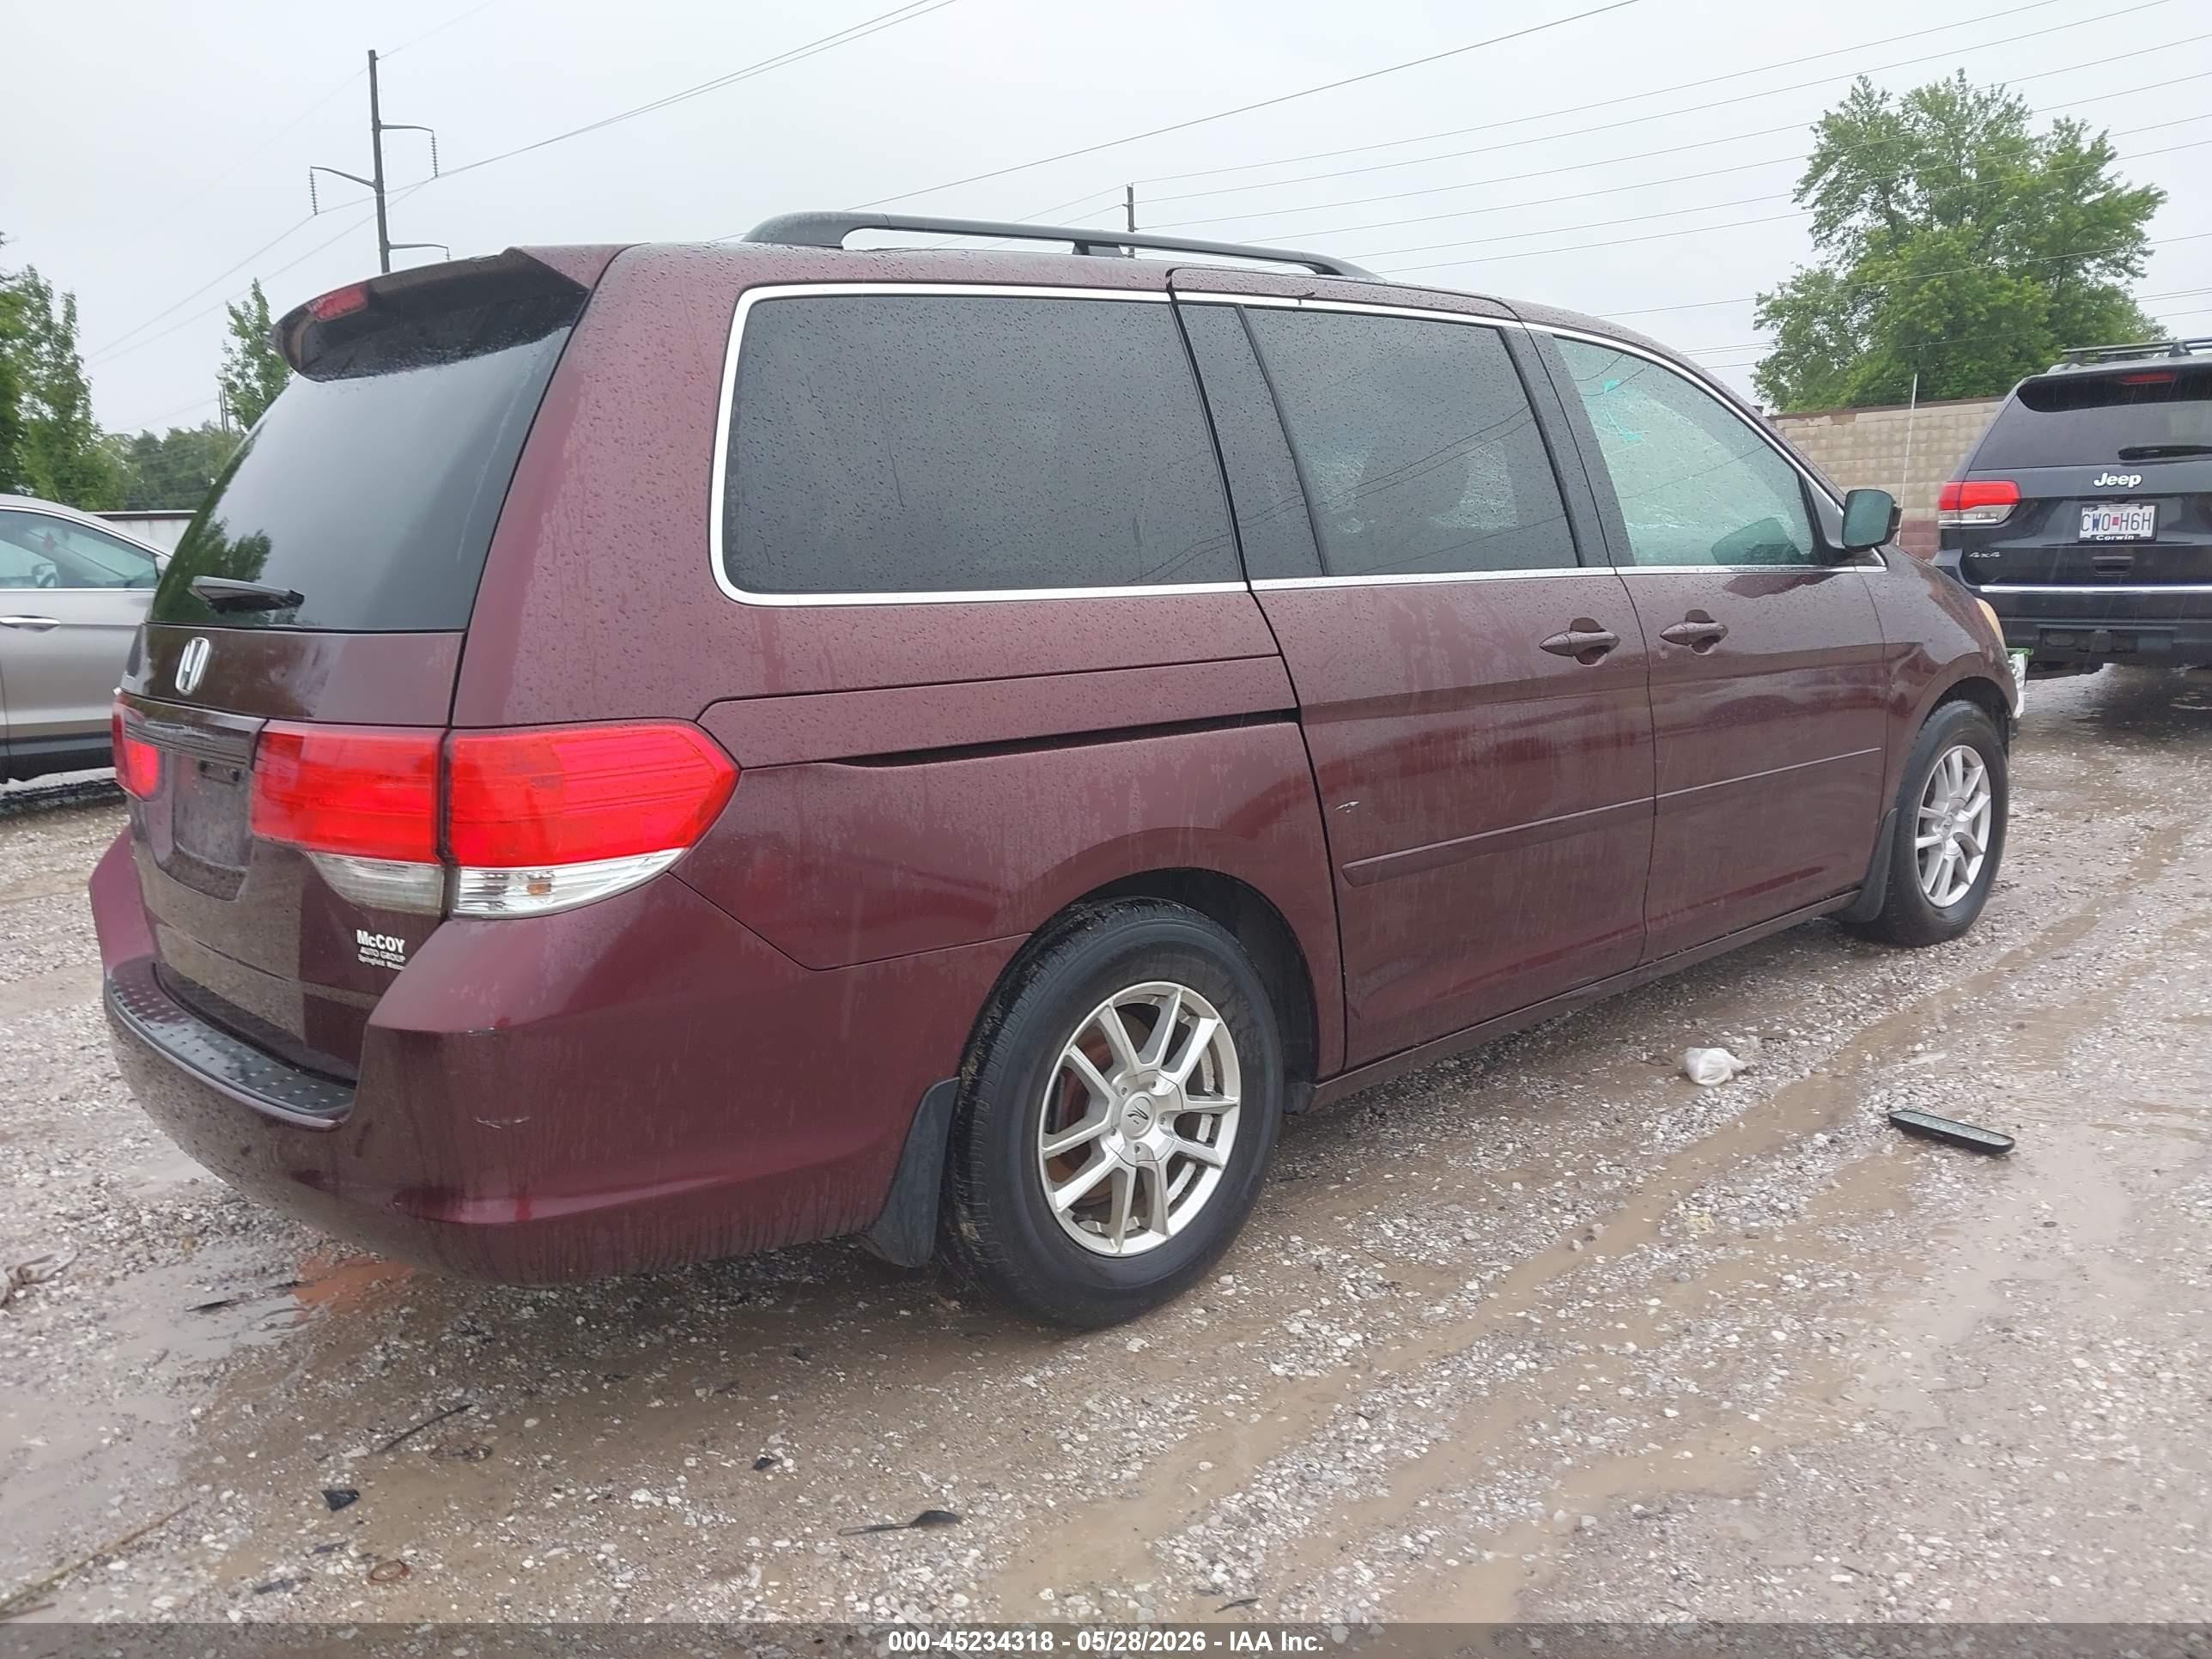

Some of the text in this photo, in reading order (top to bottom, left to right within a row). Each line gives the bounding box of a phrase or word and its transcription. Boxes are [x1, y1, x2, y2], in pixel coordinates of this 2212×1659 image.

[2094, 472, 2142, 488] Jeep
[2120, 513, 2152, 531] H6H
[356, 929, 405, 953] McCOY
